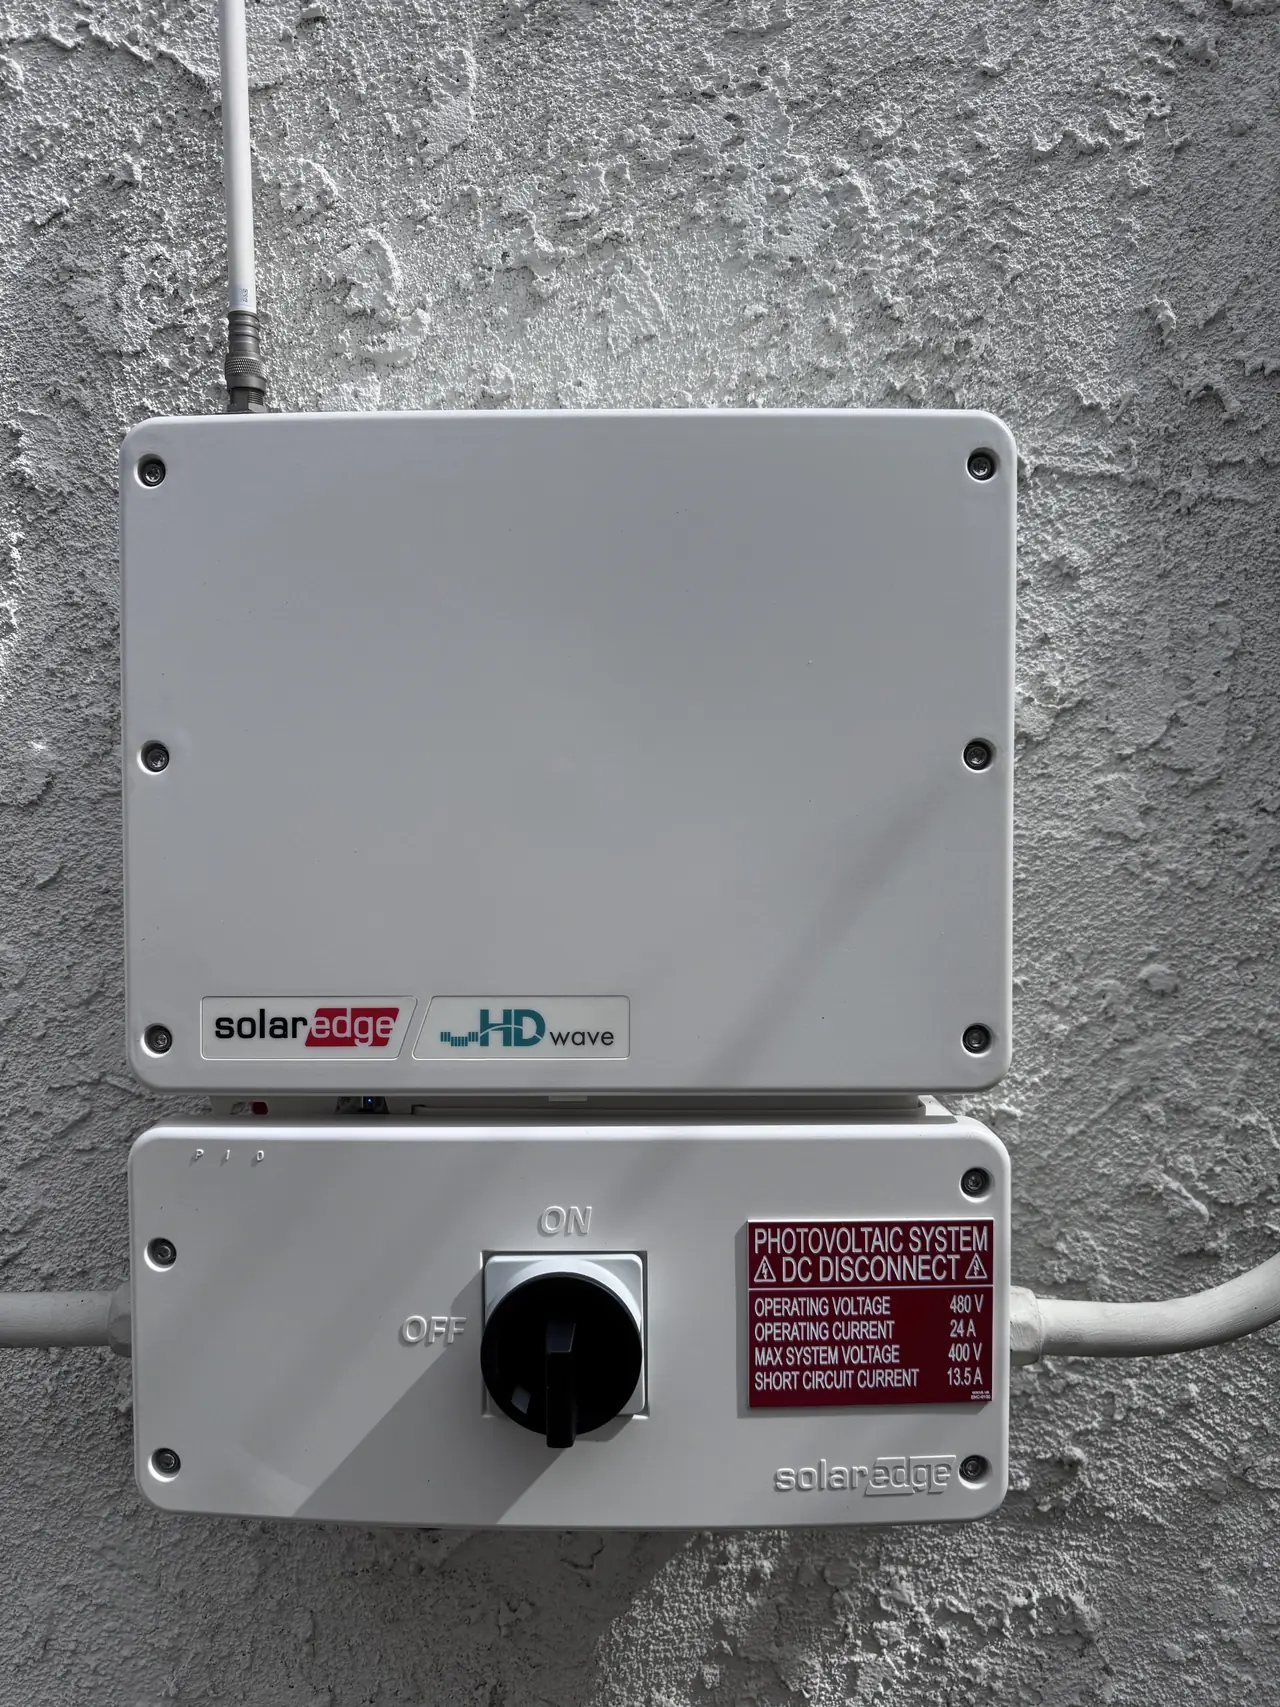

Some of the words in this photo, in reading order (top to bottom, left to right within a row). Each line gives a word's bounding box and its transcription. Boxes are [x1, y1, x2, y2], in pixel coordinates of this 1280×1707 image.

[214, 1008, 398, 1048] solaredge
[480, 1009, 546, 1047] HD
[549, 1030, 614, 1046] wave
[195, 1148, 205, 1160] P
[540, 1205, 593, 1235] ON
[754, 1227, 903, 1254] PHOTOVOLTAIC
[909, 1226, 988, 1253] SYSTEM
[782, 1256, 813, 1282] DC
[819, 1254, 960, 1282] DISCONNECT
[754, 1297, 829, 1317] OPERATING
[832, 1296, 891, 1316] VOLTAGE
[949, 1294, 972, 1313] 480
[974, 1294, 984, 1313] V
[401, 1315, 467, 1343] OFF
[754, 1322, 829, 1341] OPERATING
[832, 1320, 895, 1340] CURRENT
[949, 1319, 965, 1338] 24
[966, 1319, 977, 1337] A
[754, 1347, 783, 1366] MAX
[785, 1346, 839, 1366] SYSTEM
[841, 1345, 900, 1365] VOLTAGE
[948, 1343, 970, 1362] 400
[972, 1342, 982, 1361] V
[754, 1371, 800, 1391] SHORT
[802, 1369, 855, 1390] CIRCUIT
[857, 1368, 920, 1389] CURRENT
[947, 1367, 972, 1386] 13.5
[973, 1366, 983, 1385] A
[774, 1457, 951, 1494] solaredge
